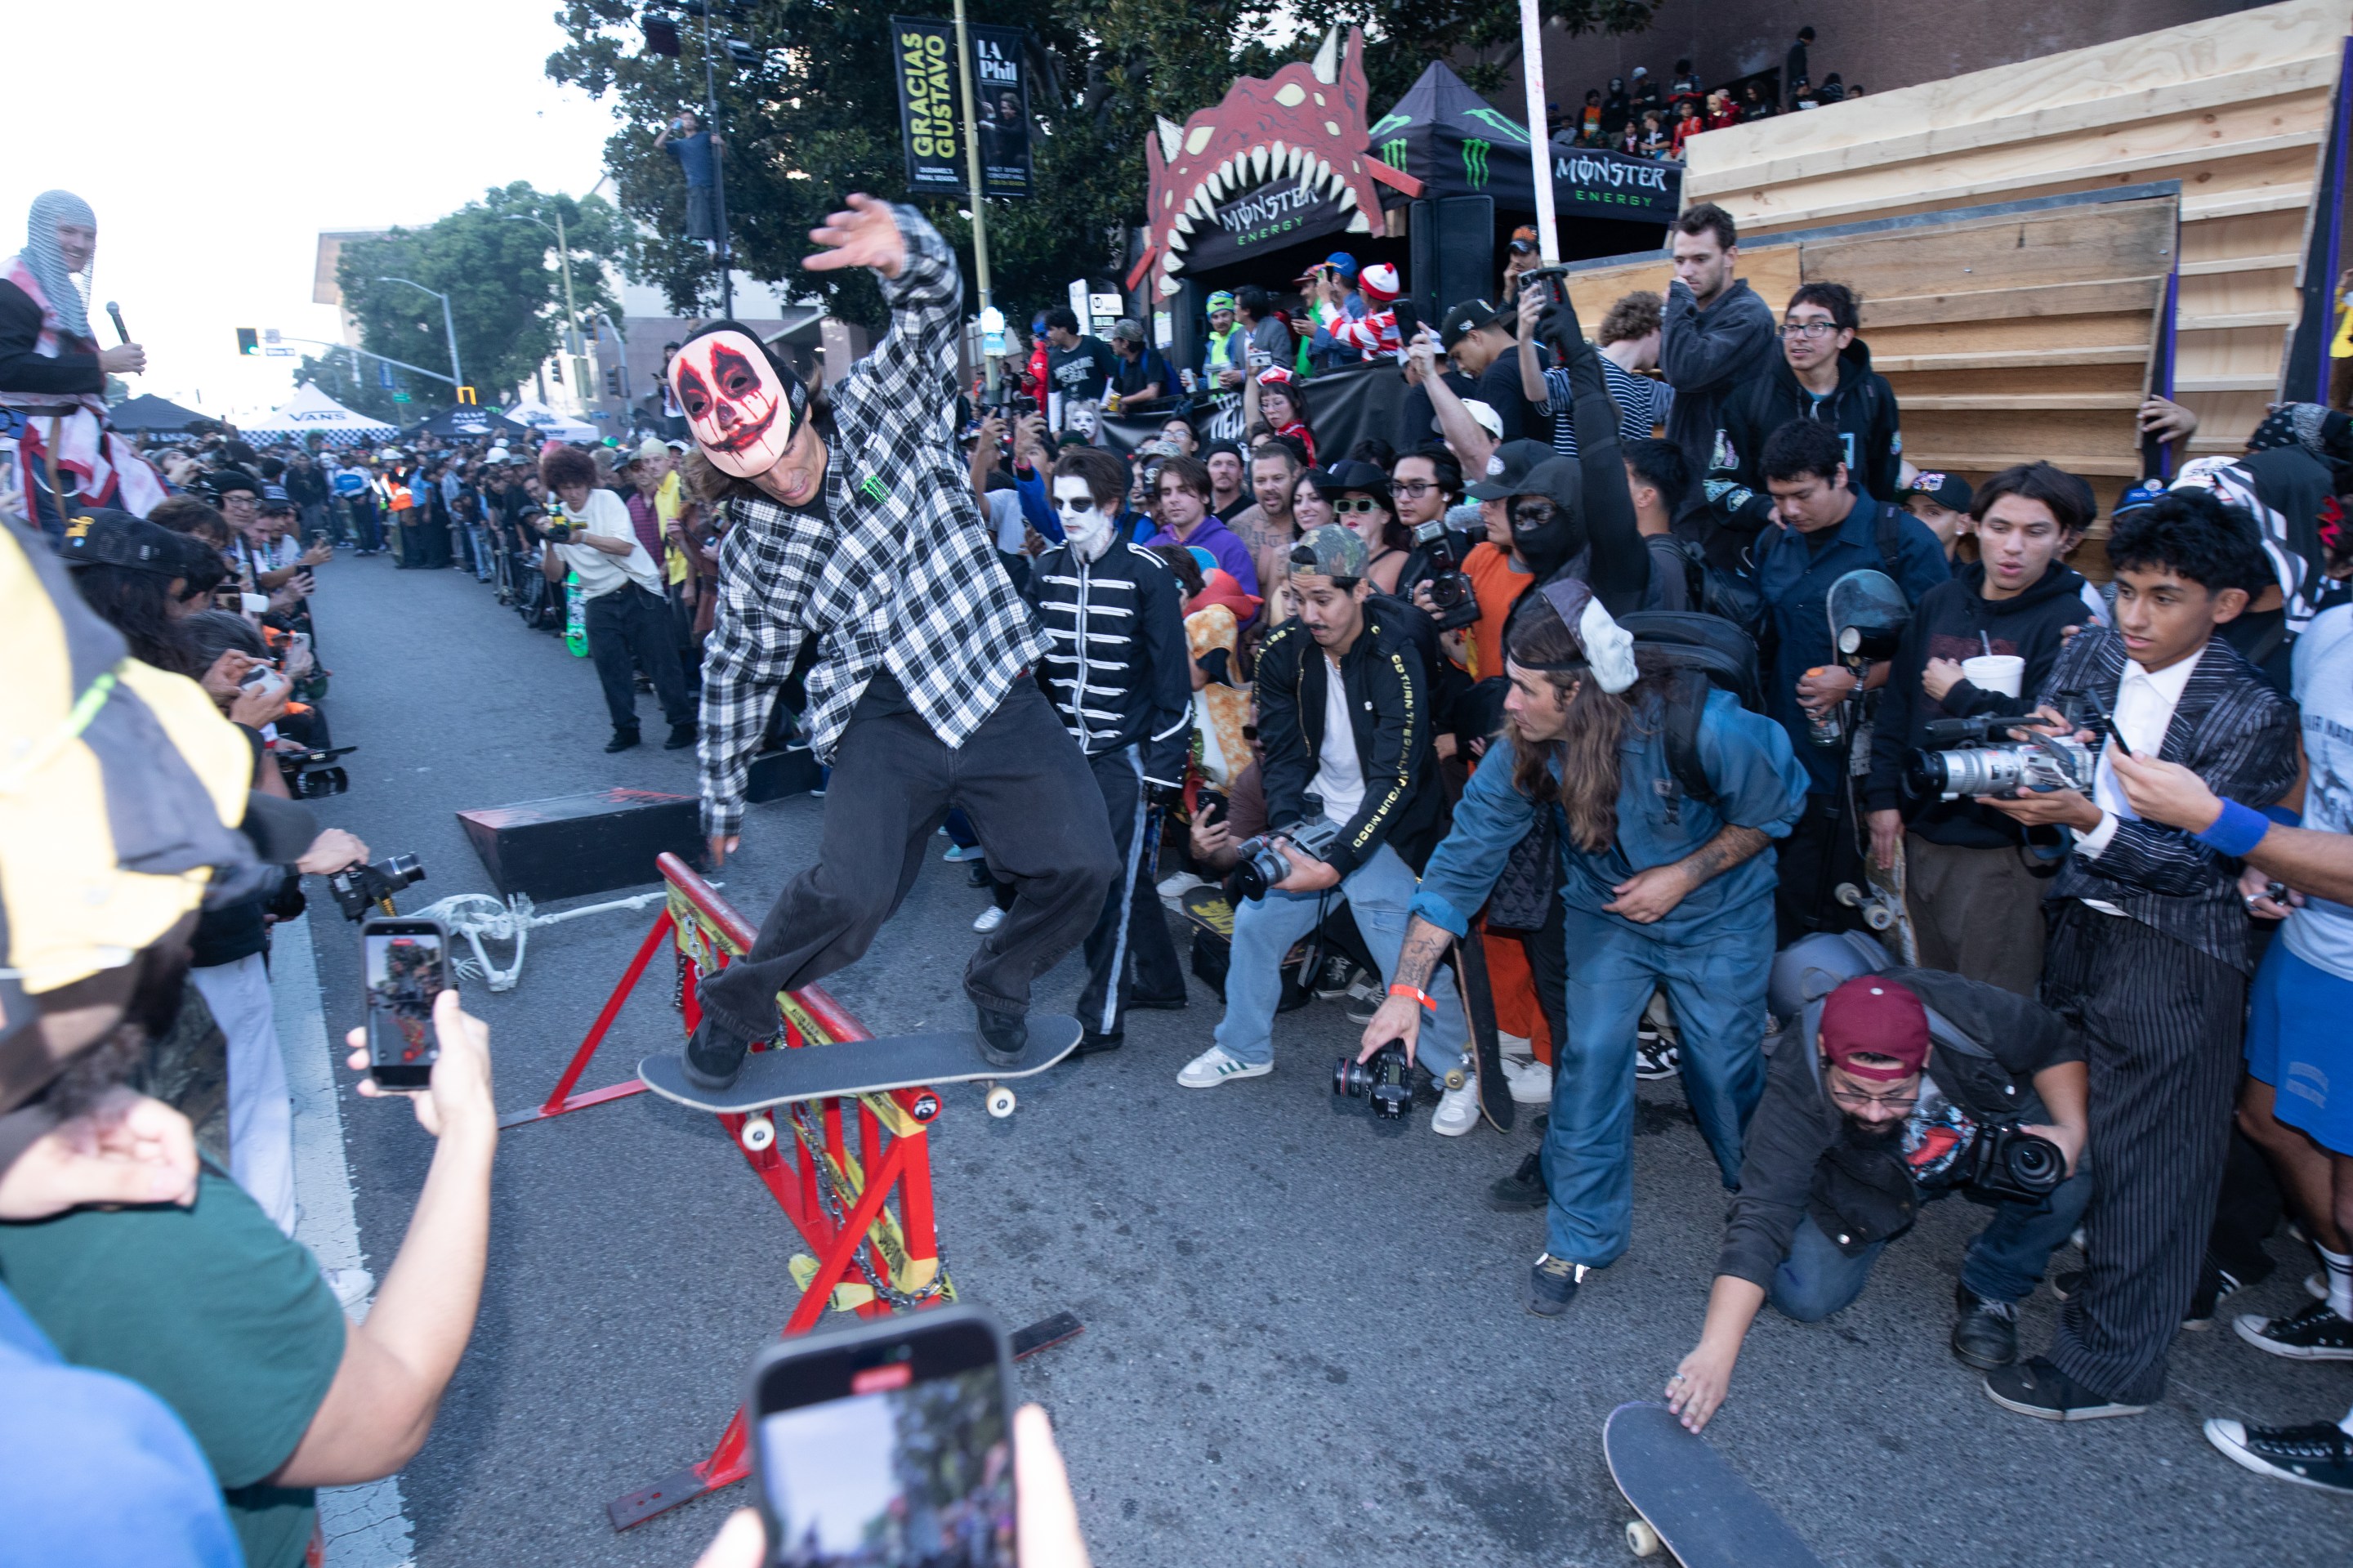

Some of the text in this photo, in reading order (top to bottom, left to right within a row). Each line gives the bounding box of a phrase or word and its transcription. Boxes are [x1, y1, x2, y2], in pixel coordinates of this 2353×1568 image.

[977, 39, 1003, 60] LA
[980, 60, 1018, 81] Phil
[901, 33, 935, 157] GRACIAS
[924, 35, 956, 159] GUSTAVO
[1556, 155, 1668, 192] MONSTER
[1221, 187, 1319, 232] MONSTER
[1575, 190, 1653, 208] ENERGY
[1237, 215, 1304, 245] ENERGY
[289, 411, 347, 422] VANS
[1400, 673, 1413, 709] TURN
[1377, 786, 1402, 815] YOUR
